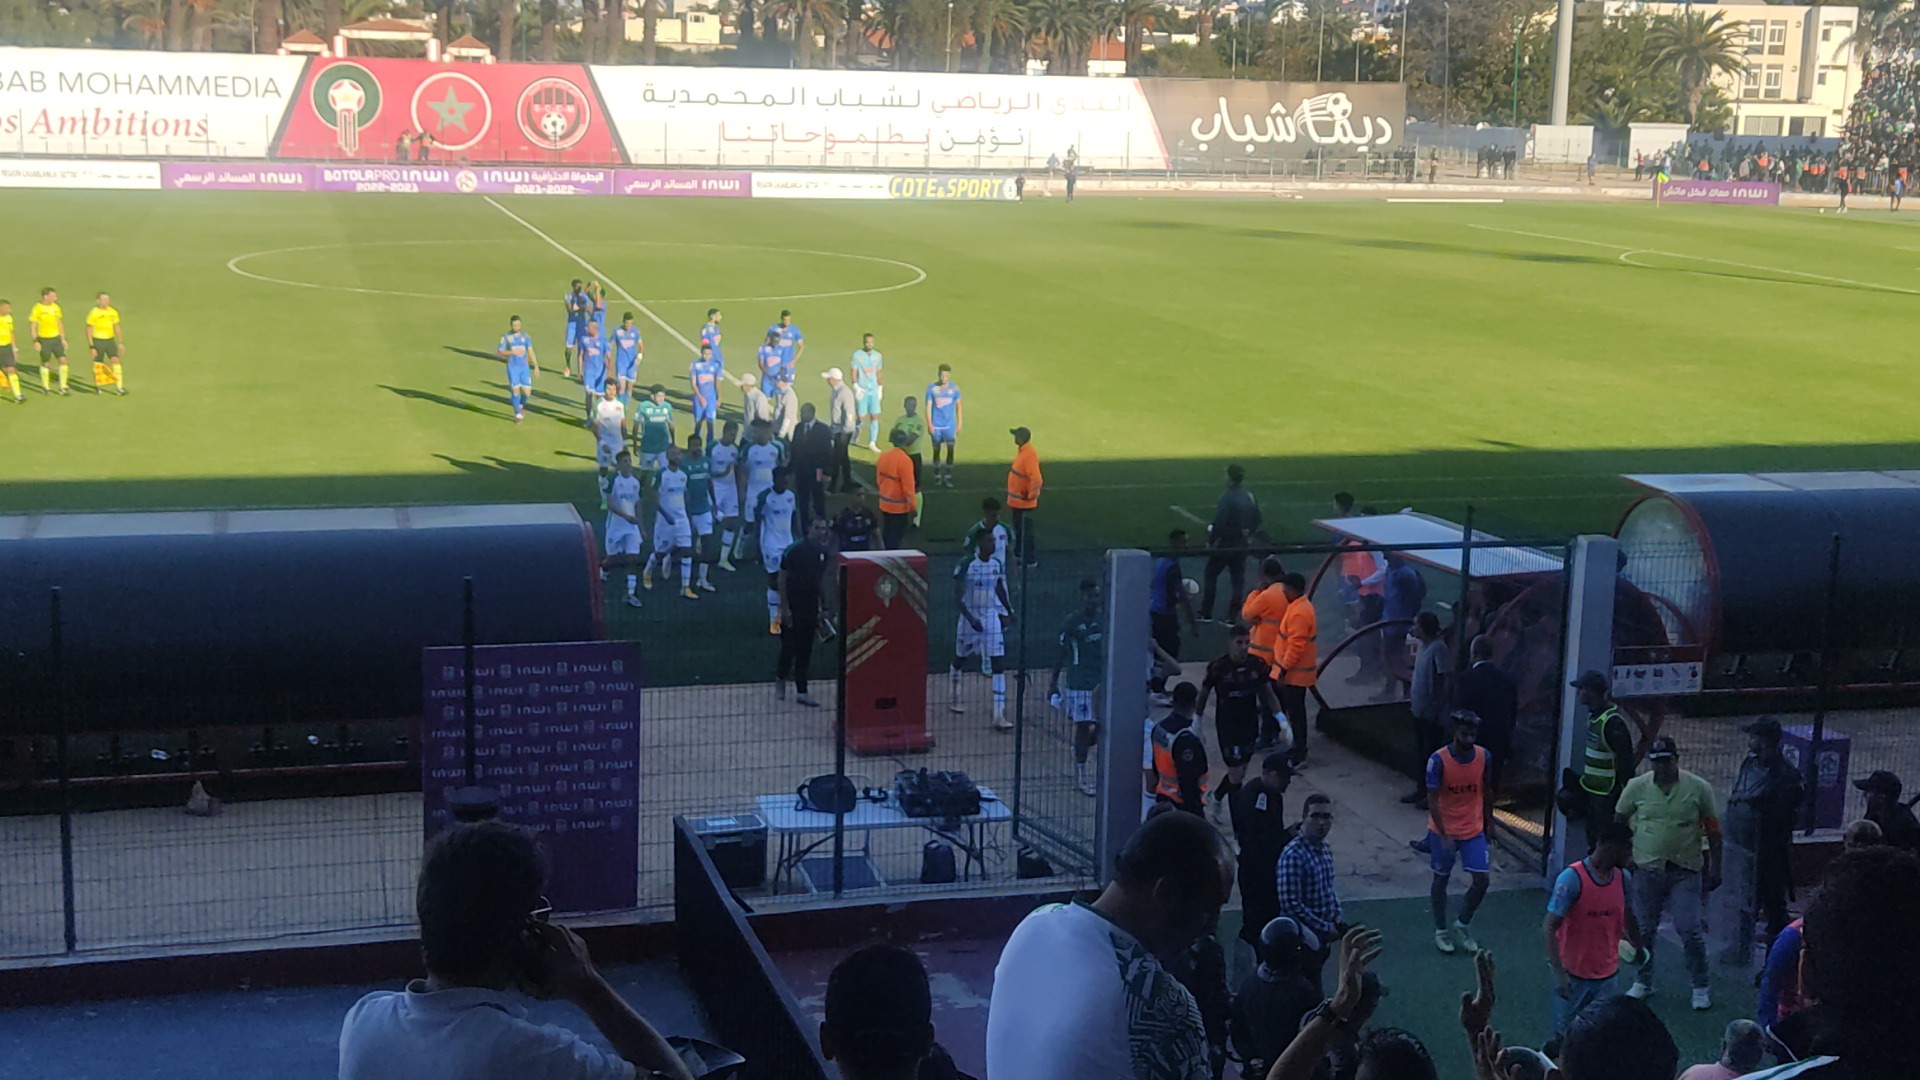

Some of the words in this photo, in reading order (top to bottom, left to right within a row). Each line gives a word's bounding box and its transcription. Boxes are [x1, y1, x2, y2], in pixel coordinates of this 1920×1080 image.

[58, 71, 282, 98] MOHAMMEDIA
[642, 82, 805, 109] المحمدية
[816, 85, 921, 112] لشباب
[931, 90, 1040, 118] الرياضي
[28, 107, 209, 137] Ambitions
[1190, 96, 1295, 152] شباب
[939, 126, 1024, 153] نؤمن
[891, 177, 1004, 198] COTE&SPORT
